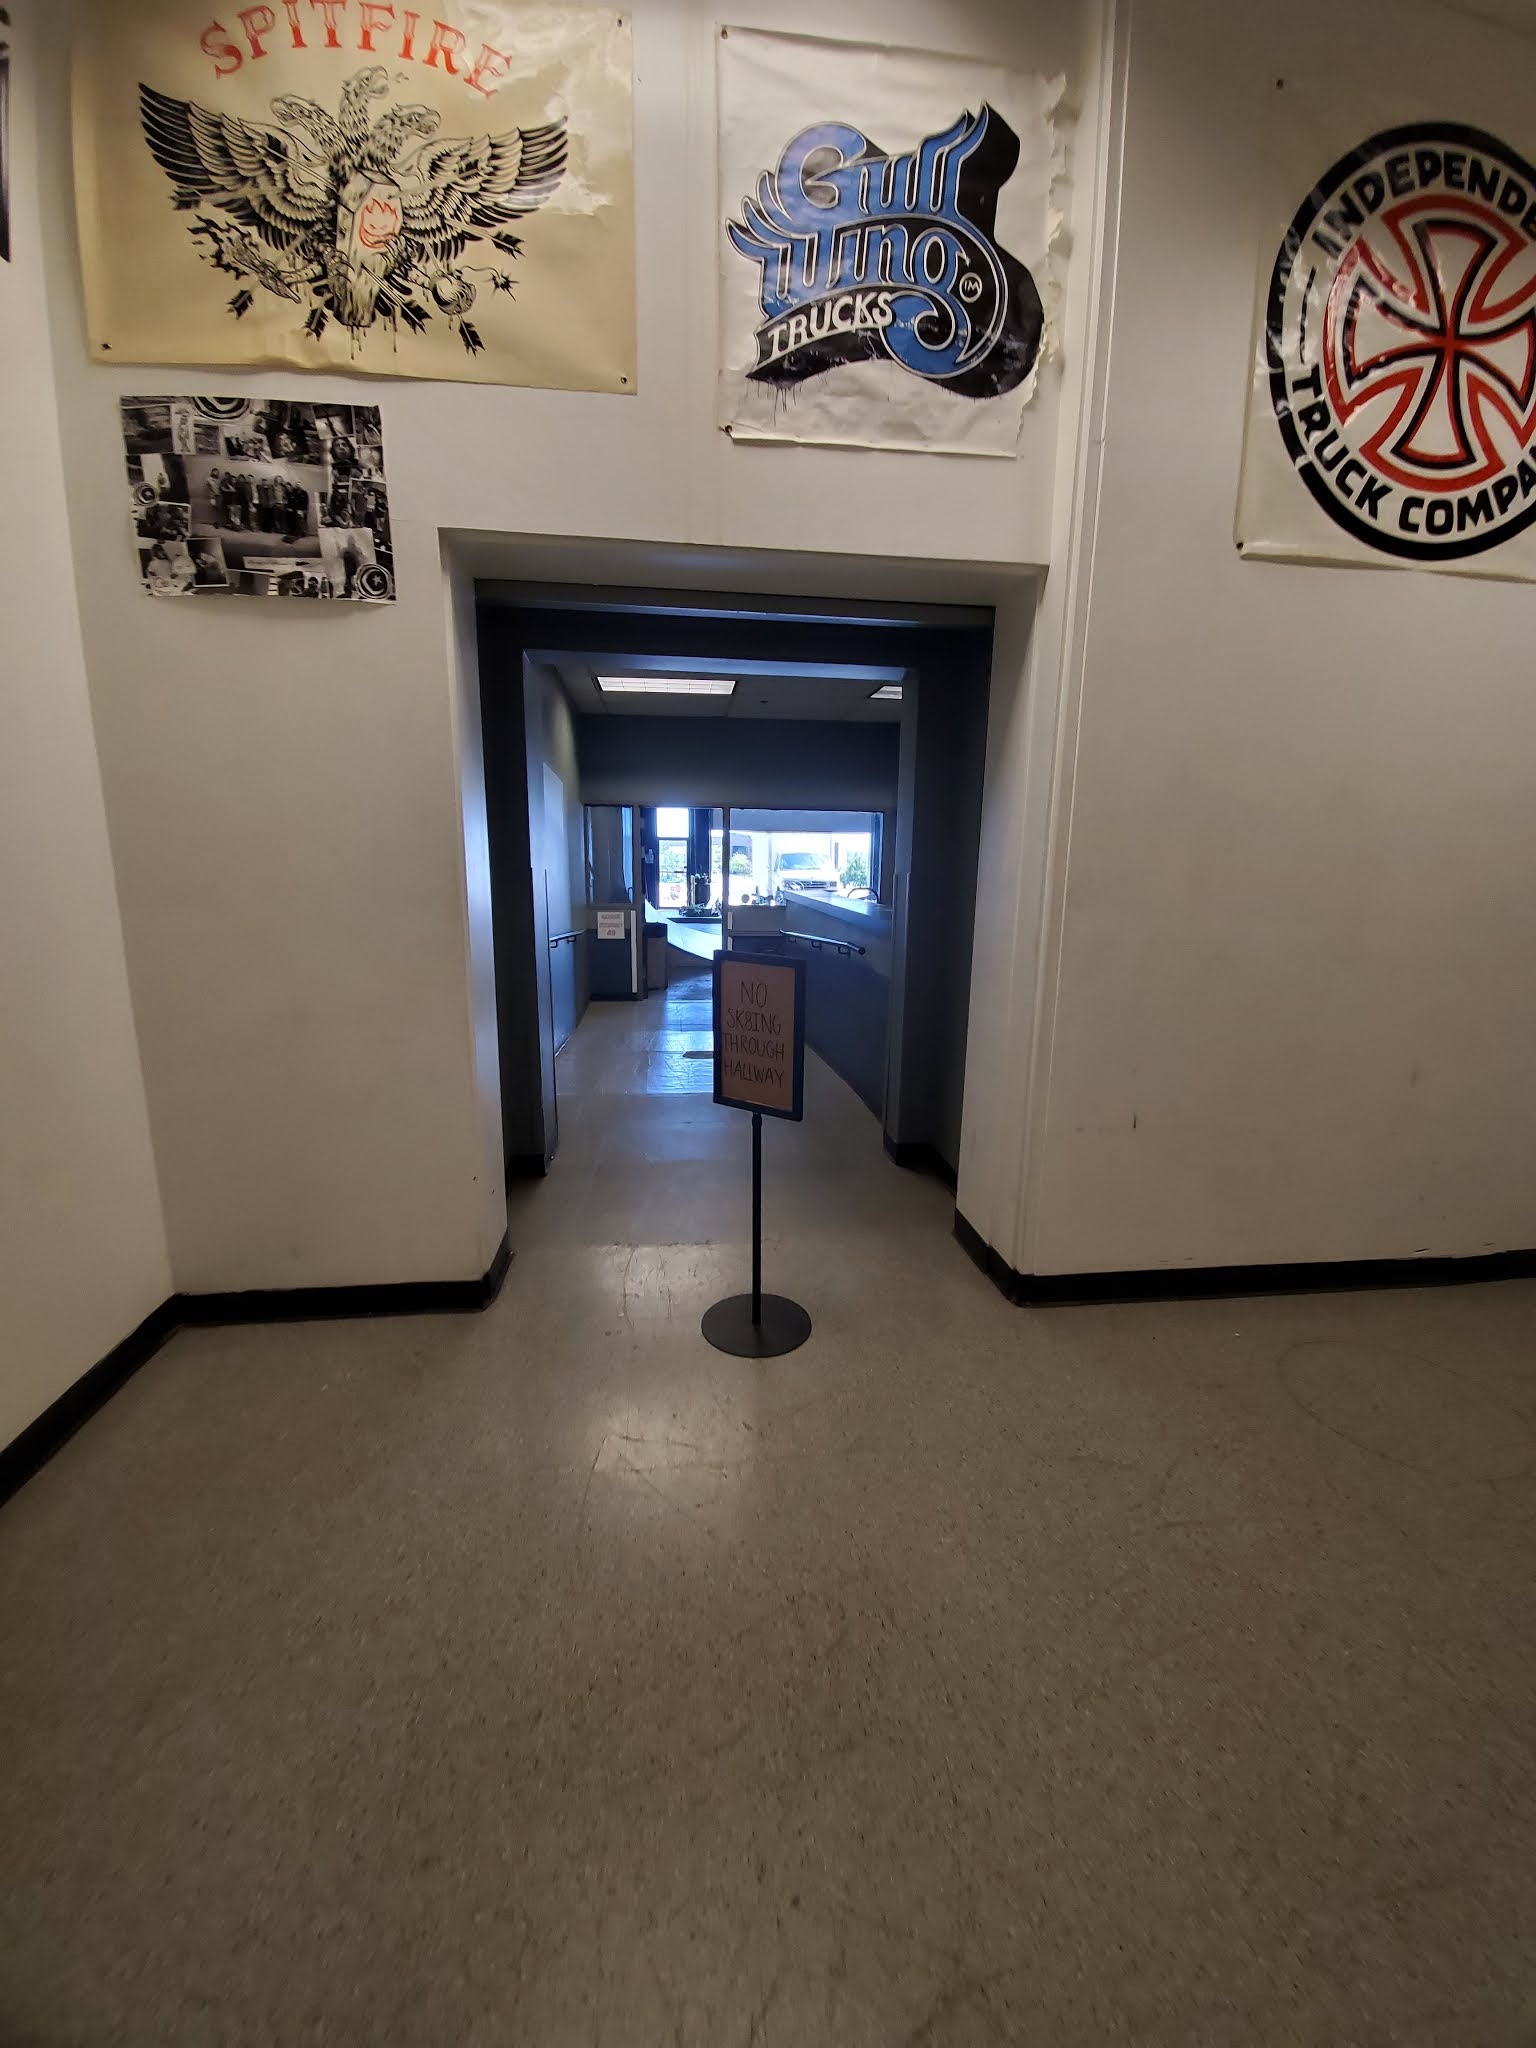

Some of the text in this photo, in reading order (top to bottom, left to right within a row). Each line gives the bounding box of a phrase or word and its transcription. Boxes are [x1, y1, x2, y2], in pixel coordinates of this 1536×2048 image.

[200, 0, 512, 99] SPITFIRE
[767, 291, 893, 357] TRUCKS
[1292, 363, 1536, 536] TRUCK COMPA
[740, 981, 769, 1008] NO
[727, 1009, 782, 1036] SK8ING
[722, 1032, 785, 1064] THROUGH
[723, 1060, 785, 1089] HALLWAY
